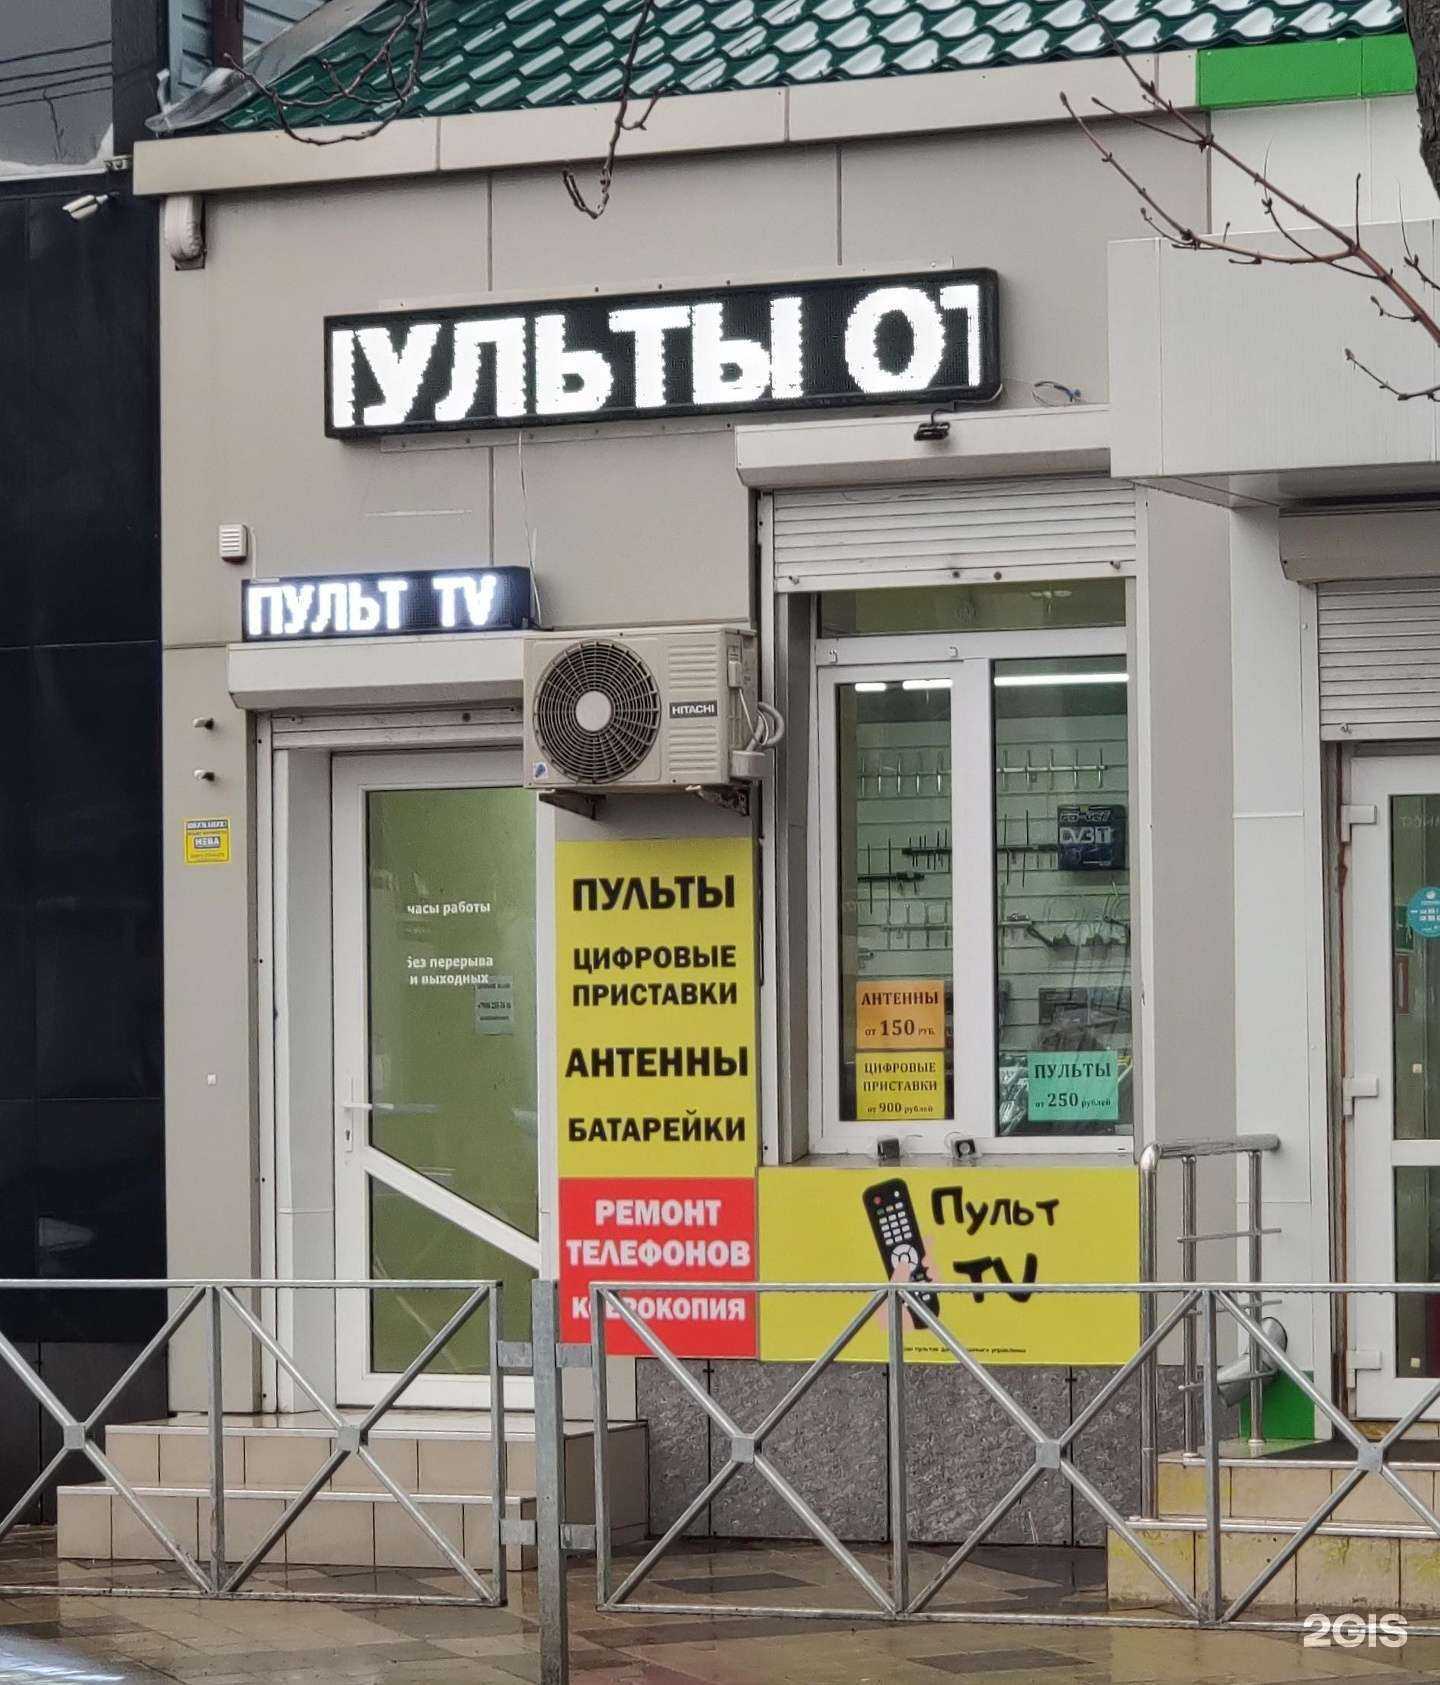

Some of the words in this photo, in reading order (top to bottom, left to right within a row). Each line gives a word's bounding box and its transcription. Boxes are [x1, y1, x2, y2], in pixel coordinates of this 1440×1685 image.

[332, 297, 804, 427] УЛЬТЫ
[248, 580, 408, 636] ПУЛЬТ
[432, 575, 497, 628] TV
[671, 703, 715, 715] HITACHI
[572, 875, 736, 912] ПУЛЬТЫ
[407, 903, 440, 914] часы
[443, 900, 491, 916] работы
[429, 956, 494, 971] перерыва
[573, 945, 737, 974] ЦИФРОВЫЕ
[409, 975, 419, 985] и
[421, 973, 489, 986] выходных
[572, 982, 738, 1007] ПРИСТАВКИ
[861, 991, 939, 1006] АНТЕННЫ
[880, 1019, 916, 1036] 150
[565, 1046, 749, 1078] АНТЕННЫ
[864, 1062, 937, 1075] ЦИФРОВЫЕ
[1034, 1062, 1112, 1079] ПУЛЬТЫ
[863, 1081, 938, 1092] ПРИСТАВКИ
[879, 1102, 902, 1113] 900
[1047, 1092, 1080, 1107] 250
[568, 1110, 746, 1143] БАТАРЕЙКИ
[595, 1199, 722, 1227] РЕМОНТ
[931, 1186, 1060, 1236] Пульт
[566, 1239, 751, 1268] ТЕЛЕФОНОВ
[953, 1253, 1038, 1303] TV
[572, 1296, 746, 1320] КЕРОКОПИЯ
